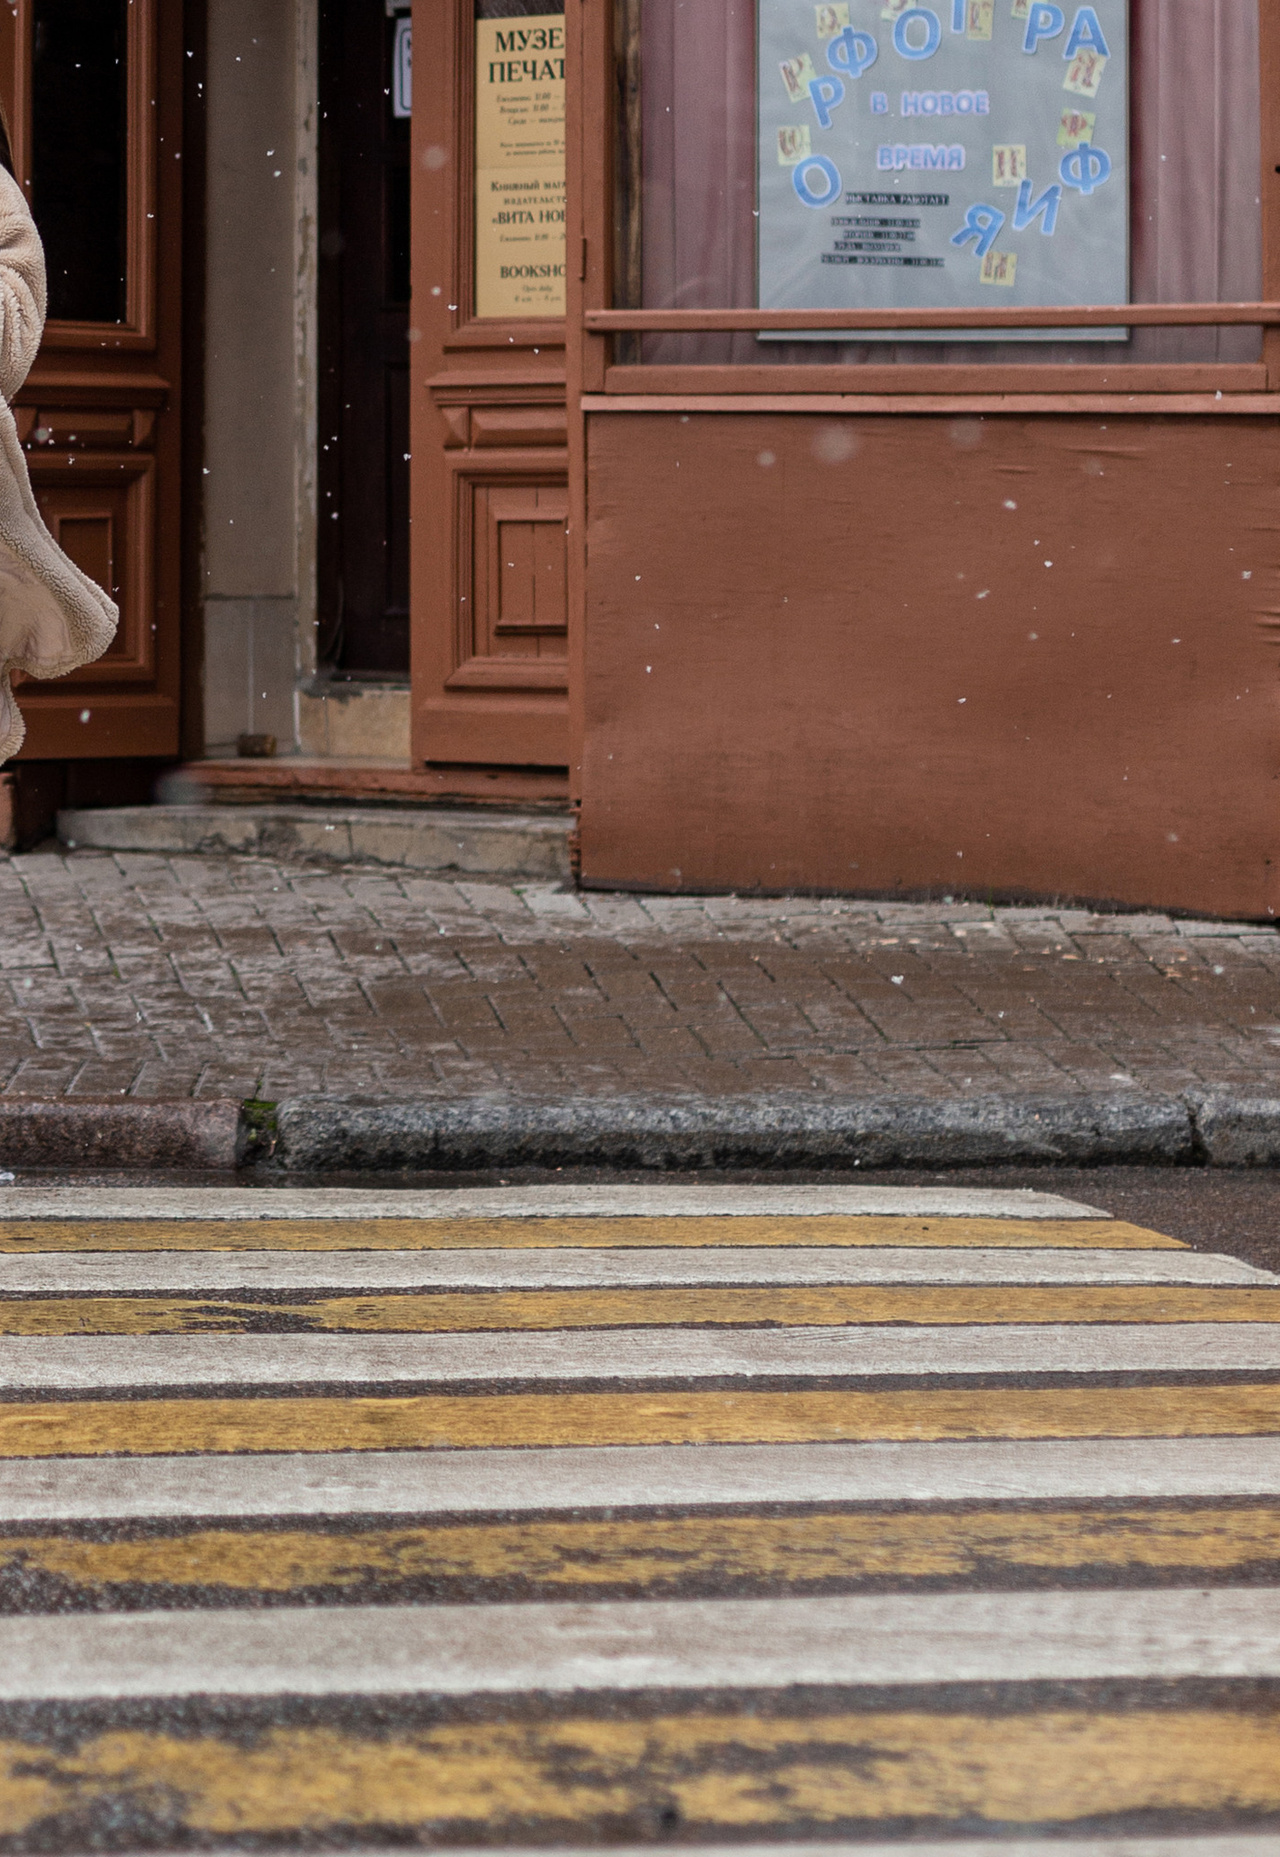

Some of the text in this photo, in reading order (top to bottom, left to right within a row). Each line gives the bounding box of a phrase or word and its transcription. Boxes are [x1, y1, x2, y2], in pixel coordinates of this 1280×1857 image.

[495, 27, 565, 52] МУЗЕ
[870, 90, 990, 117] В НОВОЕ
[877, 143, 966, 171] ВРЕМЯ
